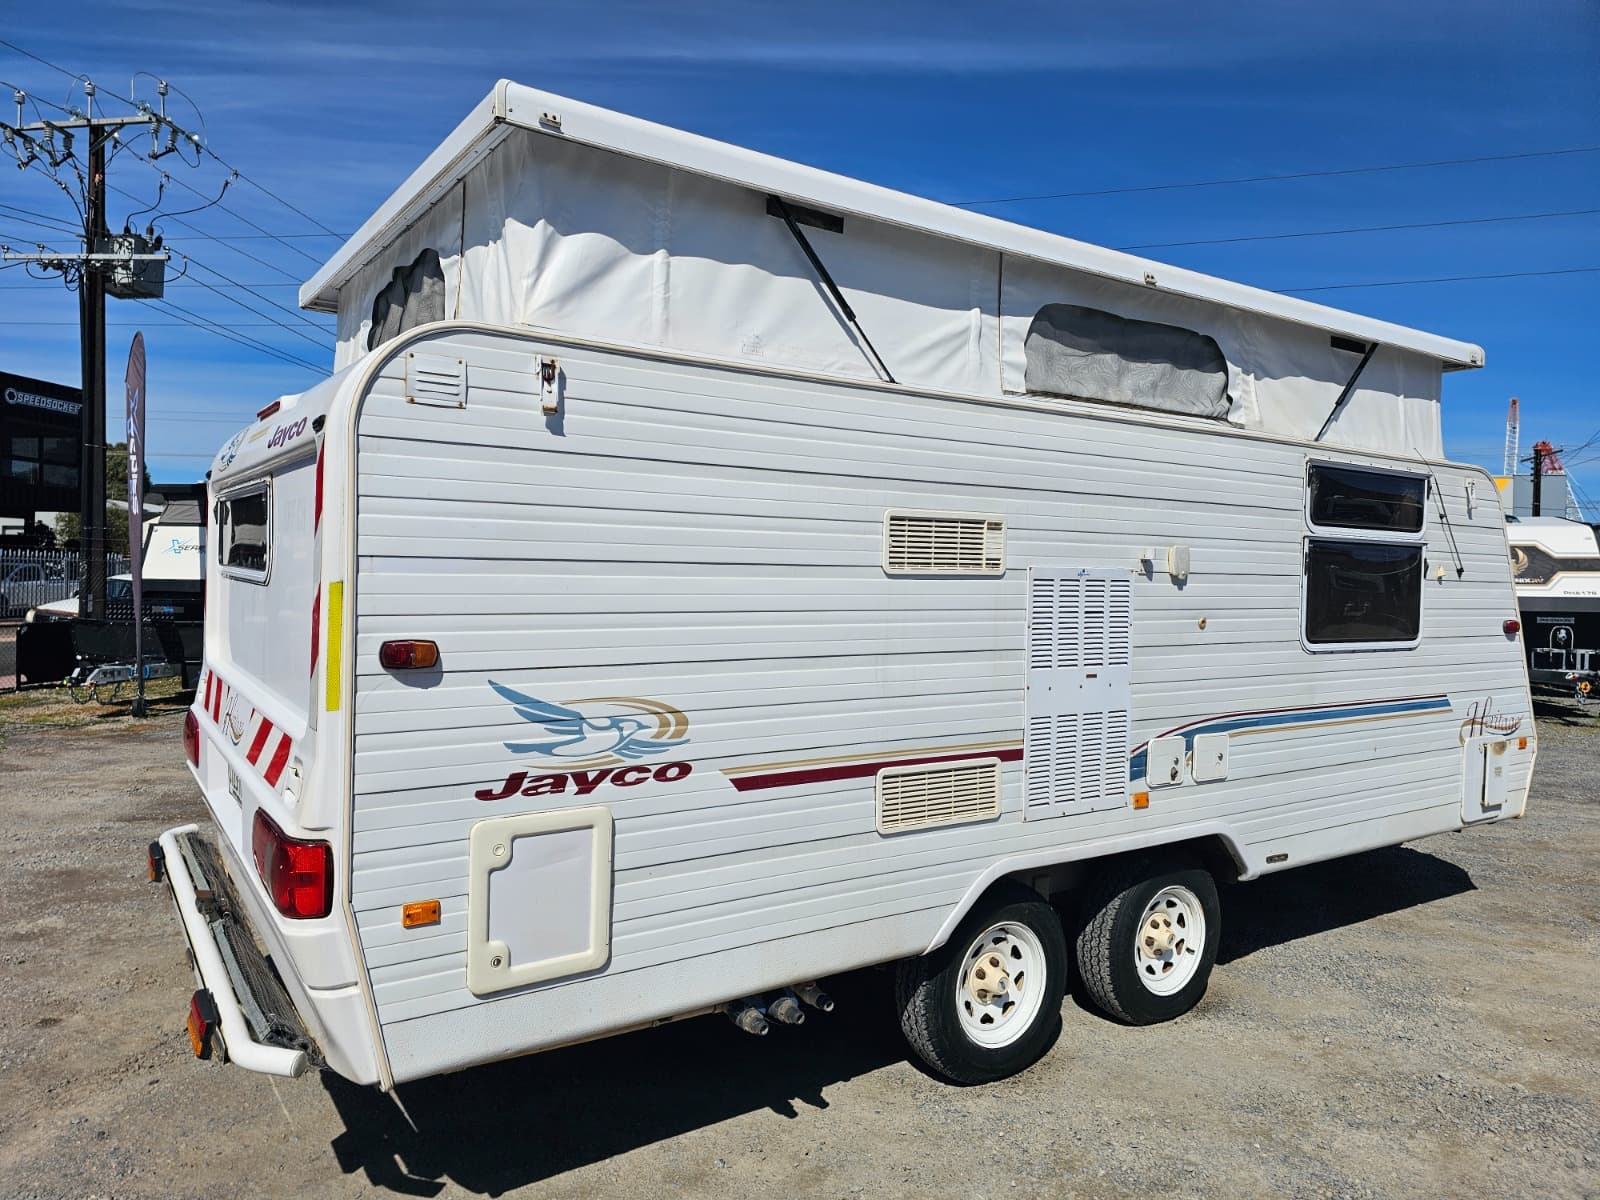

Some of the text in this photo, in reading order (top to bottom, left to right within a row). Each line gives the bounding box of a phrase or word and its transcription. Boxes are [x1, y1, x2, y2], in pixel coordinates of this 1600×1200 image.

[17, 392, 81, 414] SPEEDSOCKET
[267, 416, 308, 449] Jayco
[474, 761, 693, 801] Jayco
